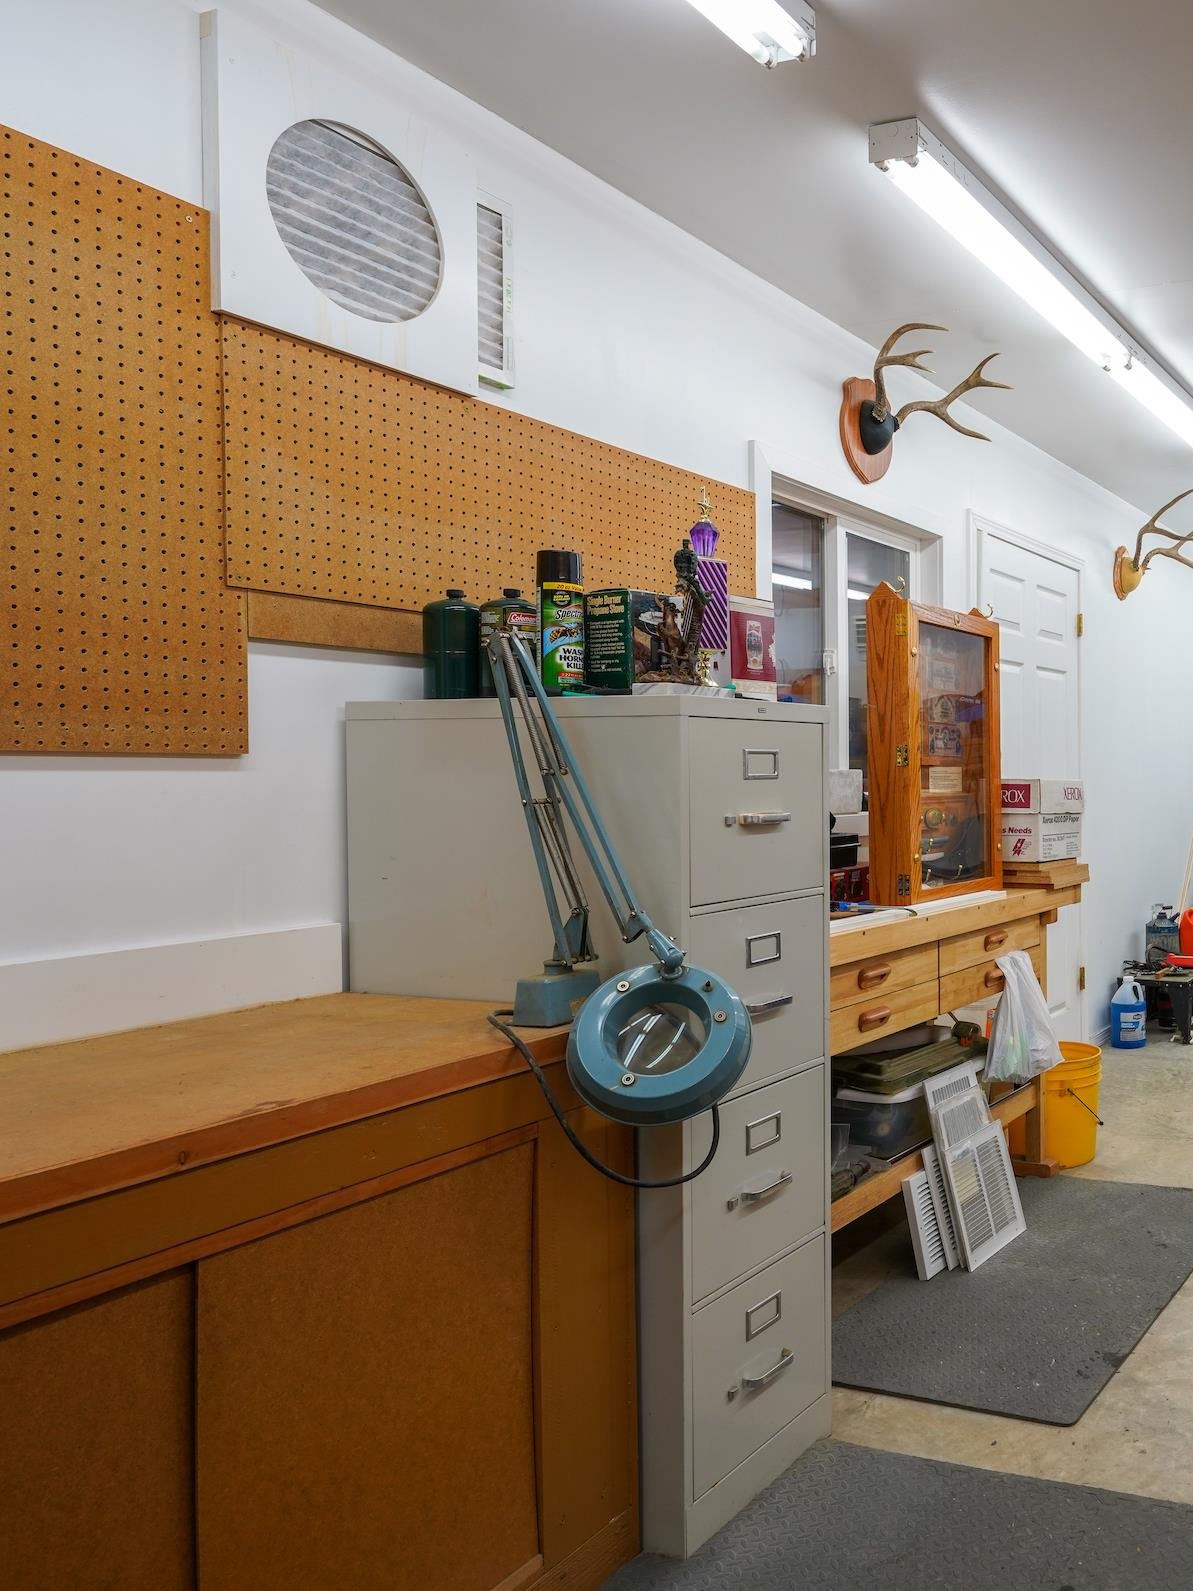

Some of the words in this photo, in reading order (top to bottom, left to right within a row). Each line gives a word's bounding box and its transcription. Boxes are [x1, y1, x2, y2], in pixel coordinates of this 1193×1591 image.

[604, 595, 622, 604] Burner
[587, 606, 610, 616] Propane
[610, 605, 624, 614] Stove
[1063, 787, 1083, 800] XEROX
[1008, 826, 1032, 834] Needs
